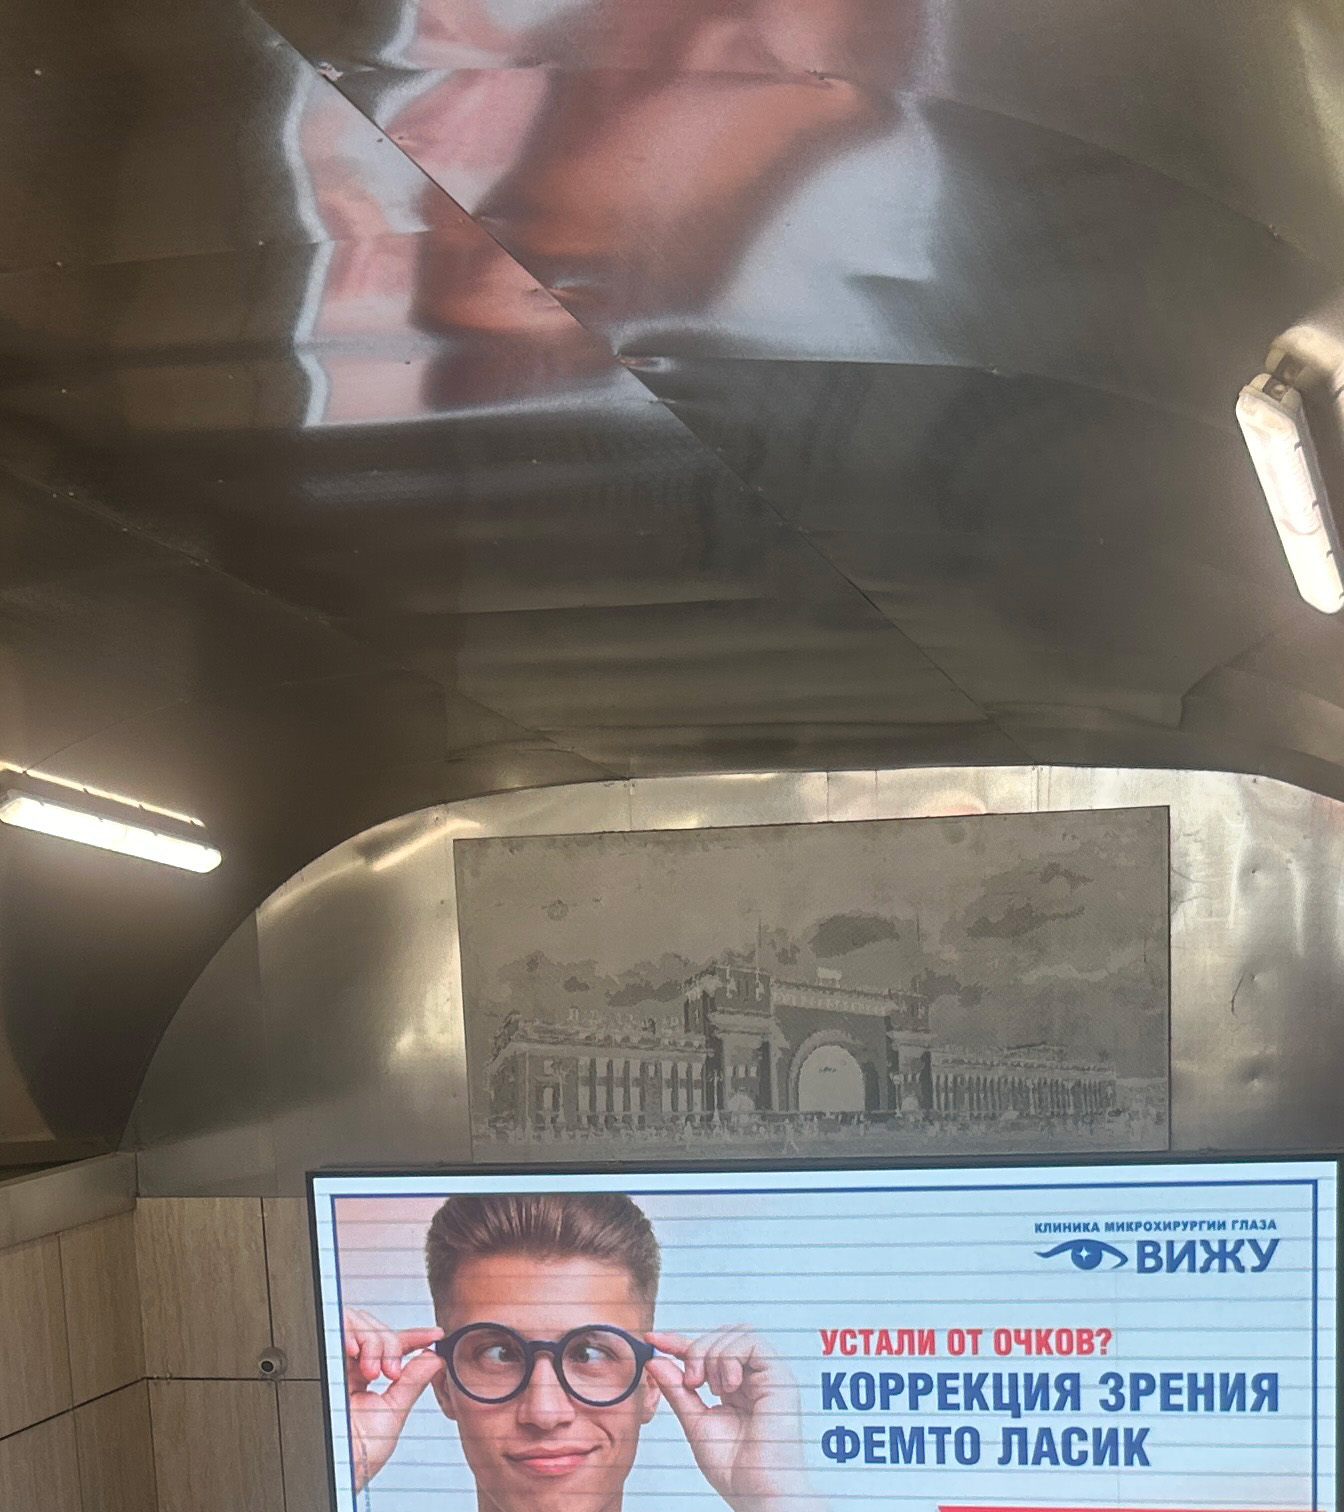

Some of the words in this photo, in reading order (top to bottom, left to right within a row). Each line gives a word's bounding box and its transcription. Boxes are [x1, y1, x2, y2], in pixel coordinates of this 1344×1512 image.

[1034, 1222, 1100, 1233] КЛИНИКА
[1105, 1220, 1227, 1232] МИКРОХИРУРГИИ
[1231, 1219, 1277, 1230] ГЛАЗА
[1136, 1238, 1281, 1273] ВИЖУ
[819, 1328, 936, 1356] УСТАЛИ
[946, 1328, 983, 1356] ОТ
[993, 1327, 1112, 1356] ОЧКОВ?
[821, 1371, 1081, 1418] КОРРЕКЦИЯ
[1098, 1371, 1279, 1412] ЗРЕНИЯ
[820, 1424, 981, 1465] ФЕМТО
[997, 1426, 1152, 1467] ЛАСИК
